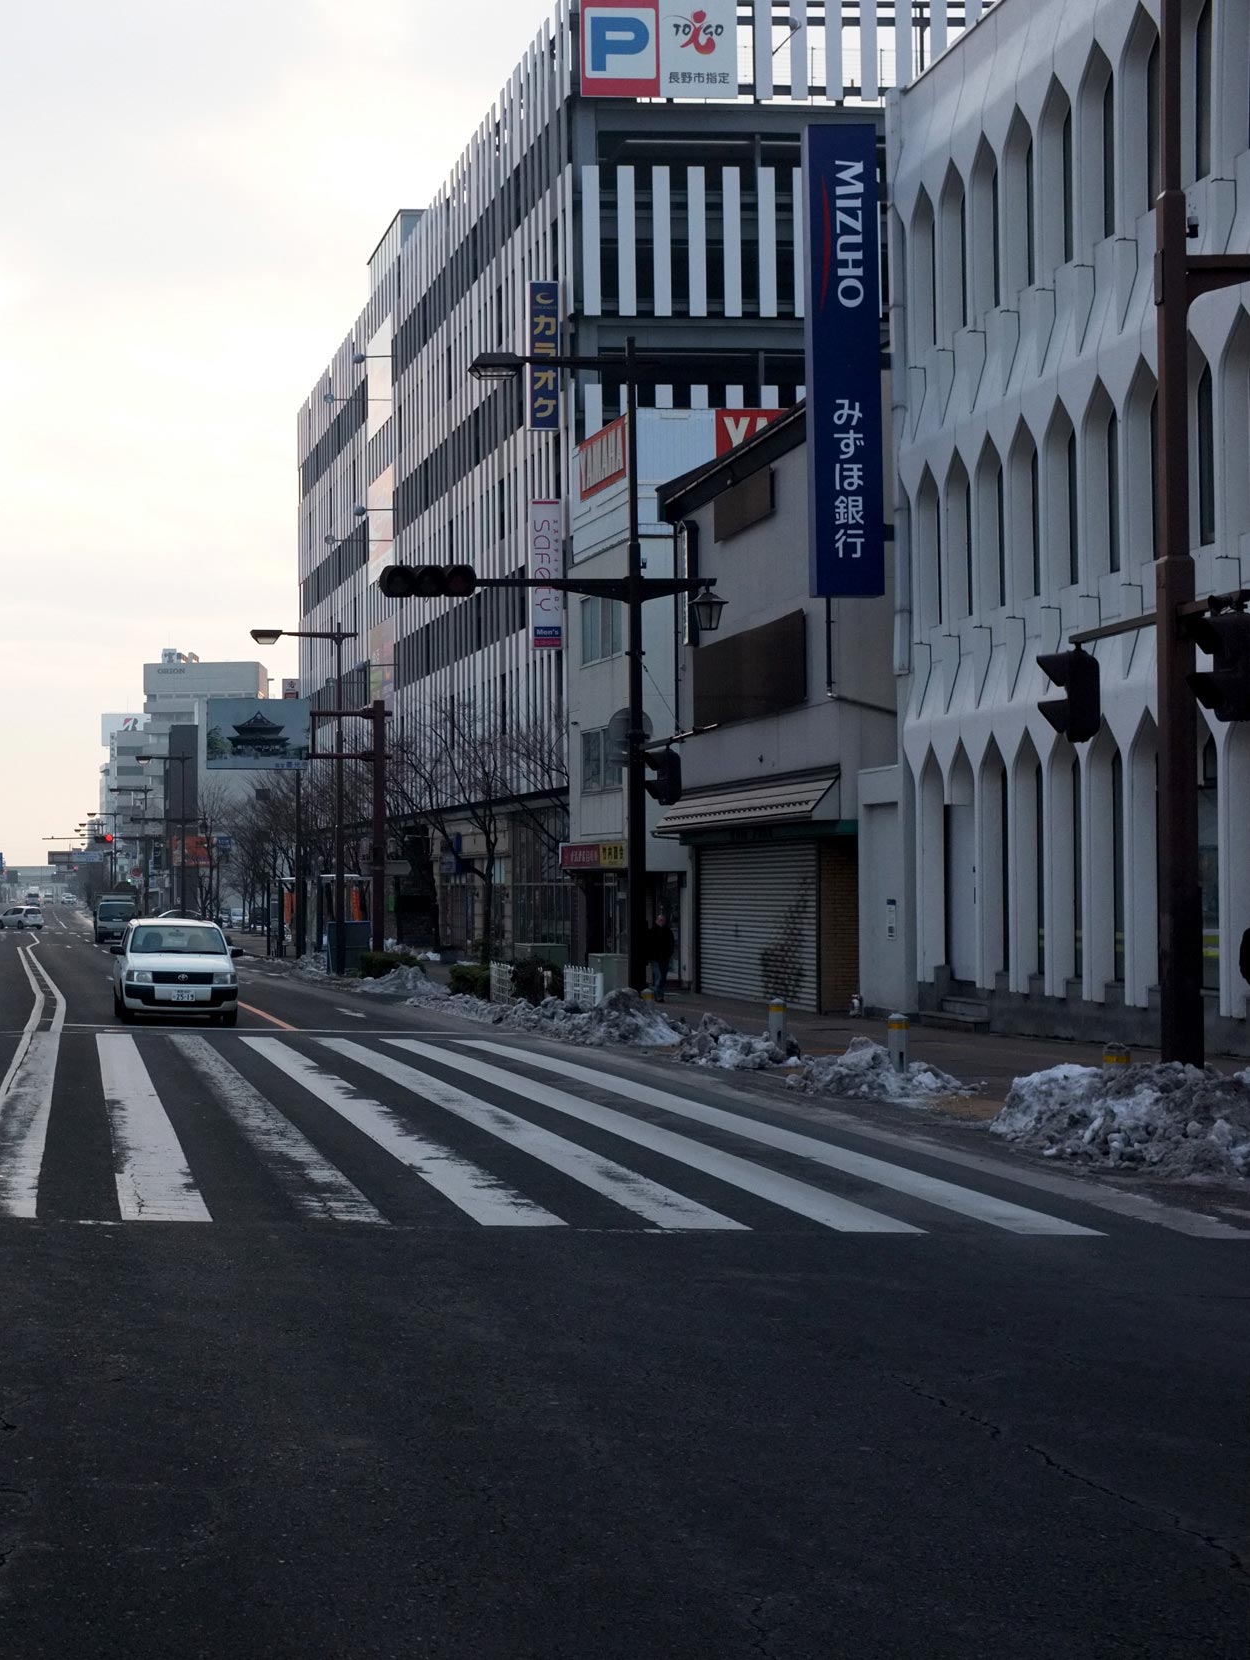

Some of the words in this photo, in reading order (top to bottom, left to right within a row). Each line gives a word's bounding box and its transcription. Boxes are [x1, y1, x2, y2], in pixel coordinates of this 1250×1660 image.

[591, 17, 649, 71] P
[668, 72, 730, 84] 長野市指定
[835, 160, 864, 308] MIZUHO
[533, 315, 557, 418] カラオケ
[579, 426, 625, 492] YAMAHA
[833, 399, 865, 558] みずほ銀行
